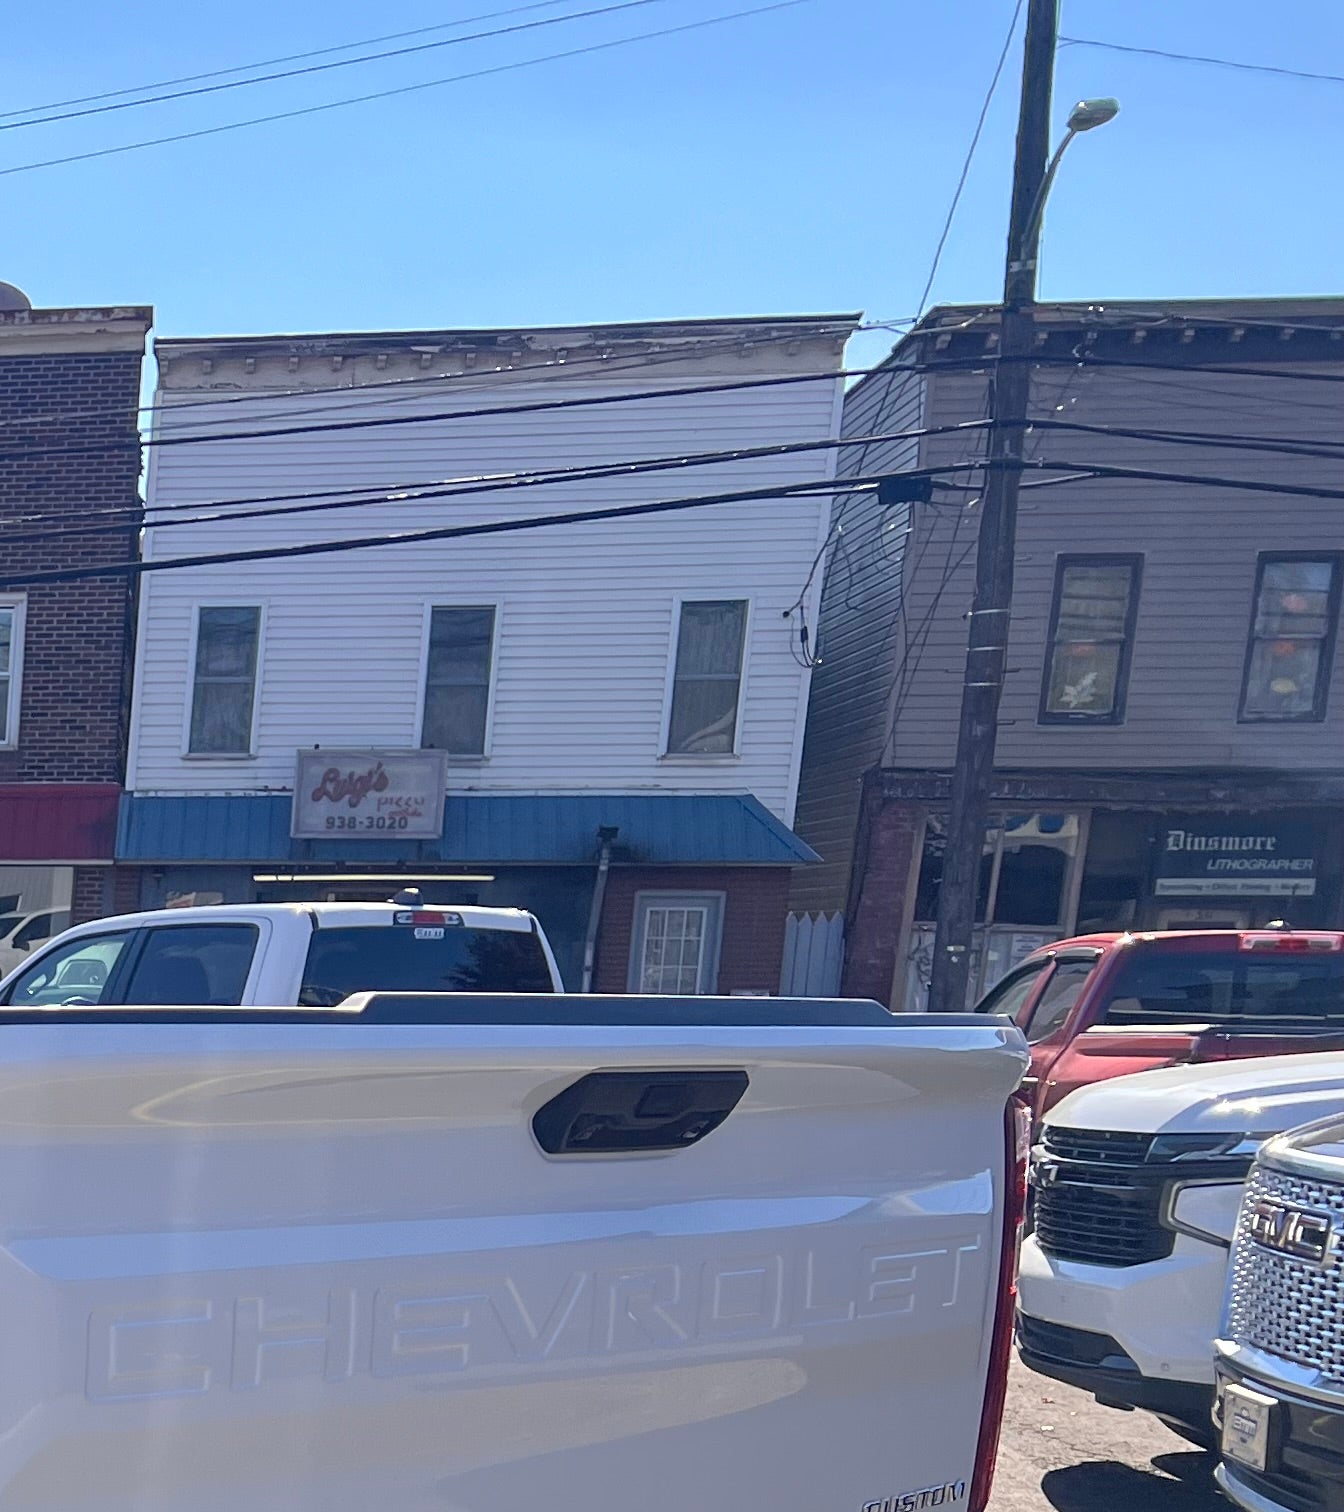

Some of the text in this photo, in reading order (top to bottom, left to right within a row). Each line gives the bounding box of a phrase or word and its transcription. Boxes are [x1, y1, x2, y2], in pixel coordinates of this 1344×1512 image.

[312, 761, 389, 808] Luigi's
[325, 815, 409, 830] 938-3020
[1166, 830, 1277, 851] Dinsmore
[1206, 858, 1314, 870] LITHOGRAPHER
[1250, 1202, 1329, 1256] GMC
[86, 1234, 981, 1399] CHEVROLET
